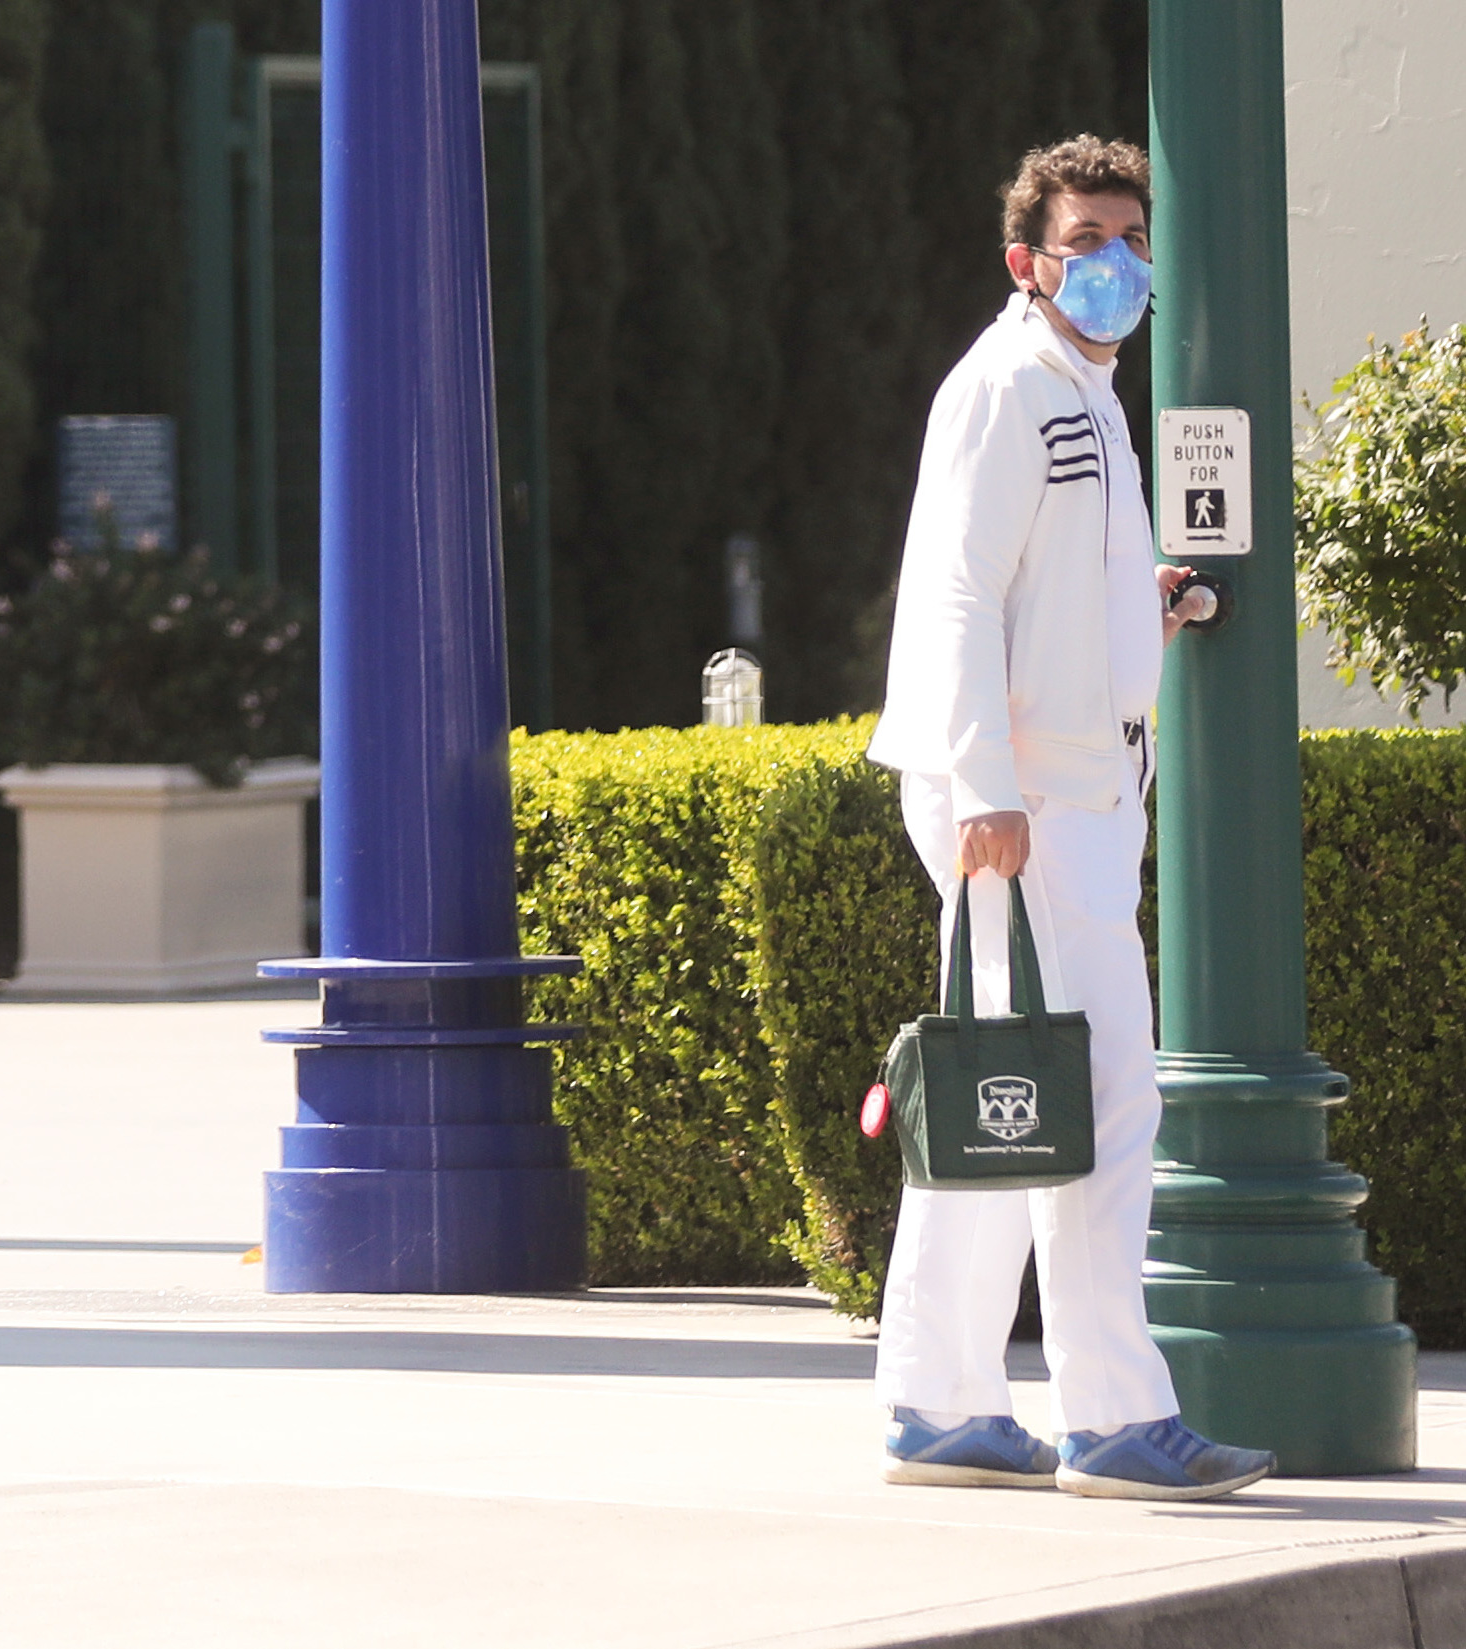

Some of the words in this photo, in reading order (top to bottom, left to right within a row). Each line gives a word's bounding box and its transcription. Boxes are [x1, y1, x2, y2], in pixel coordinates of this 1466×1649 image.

[1183, 424, 1224, 440] PUSH
[1174, 445, 1235, 461] BUTTON
[1190, 466, 1219, 482] FOR
